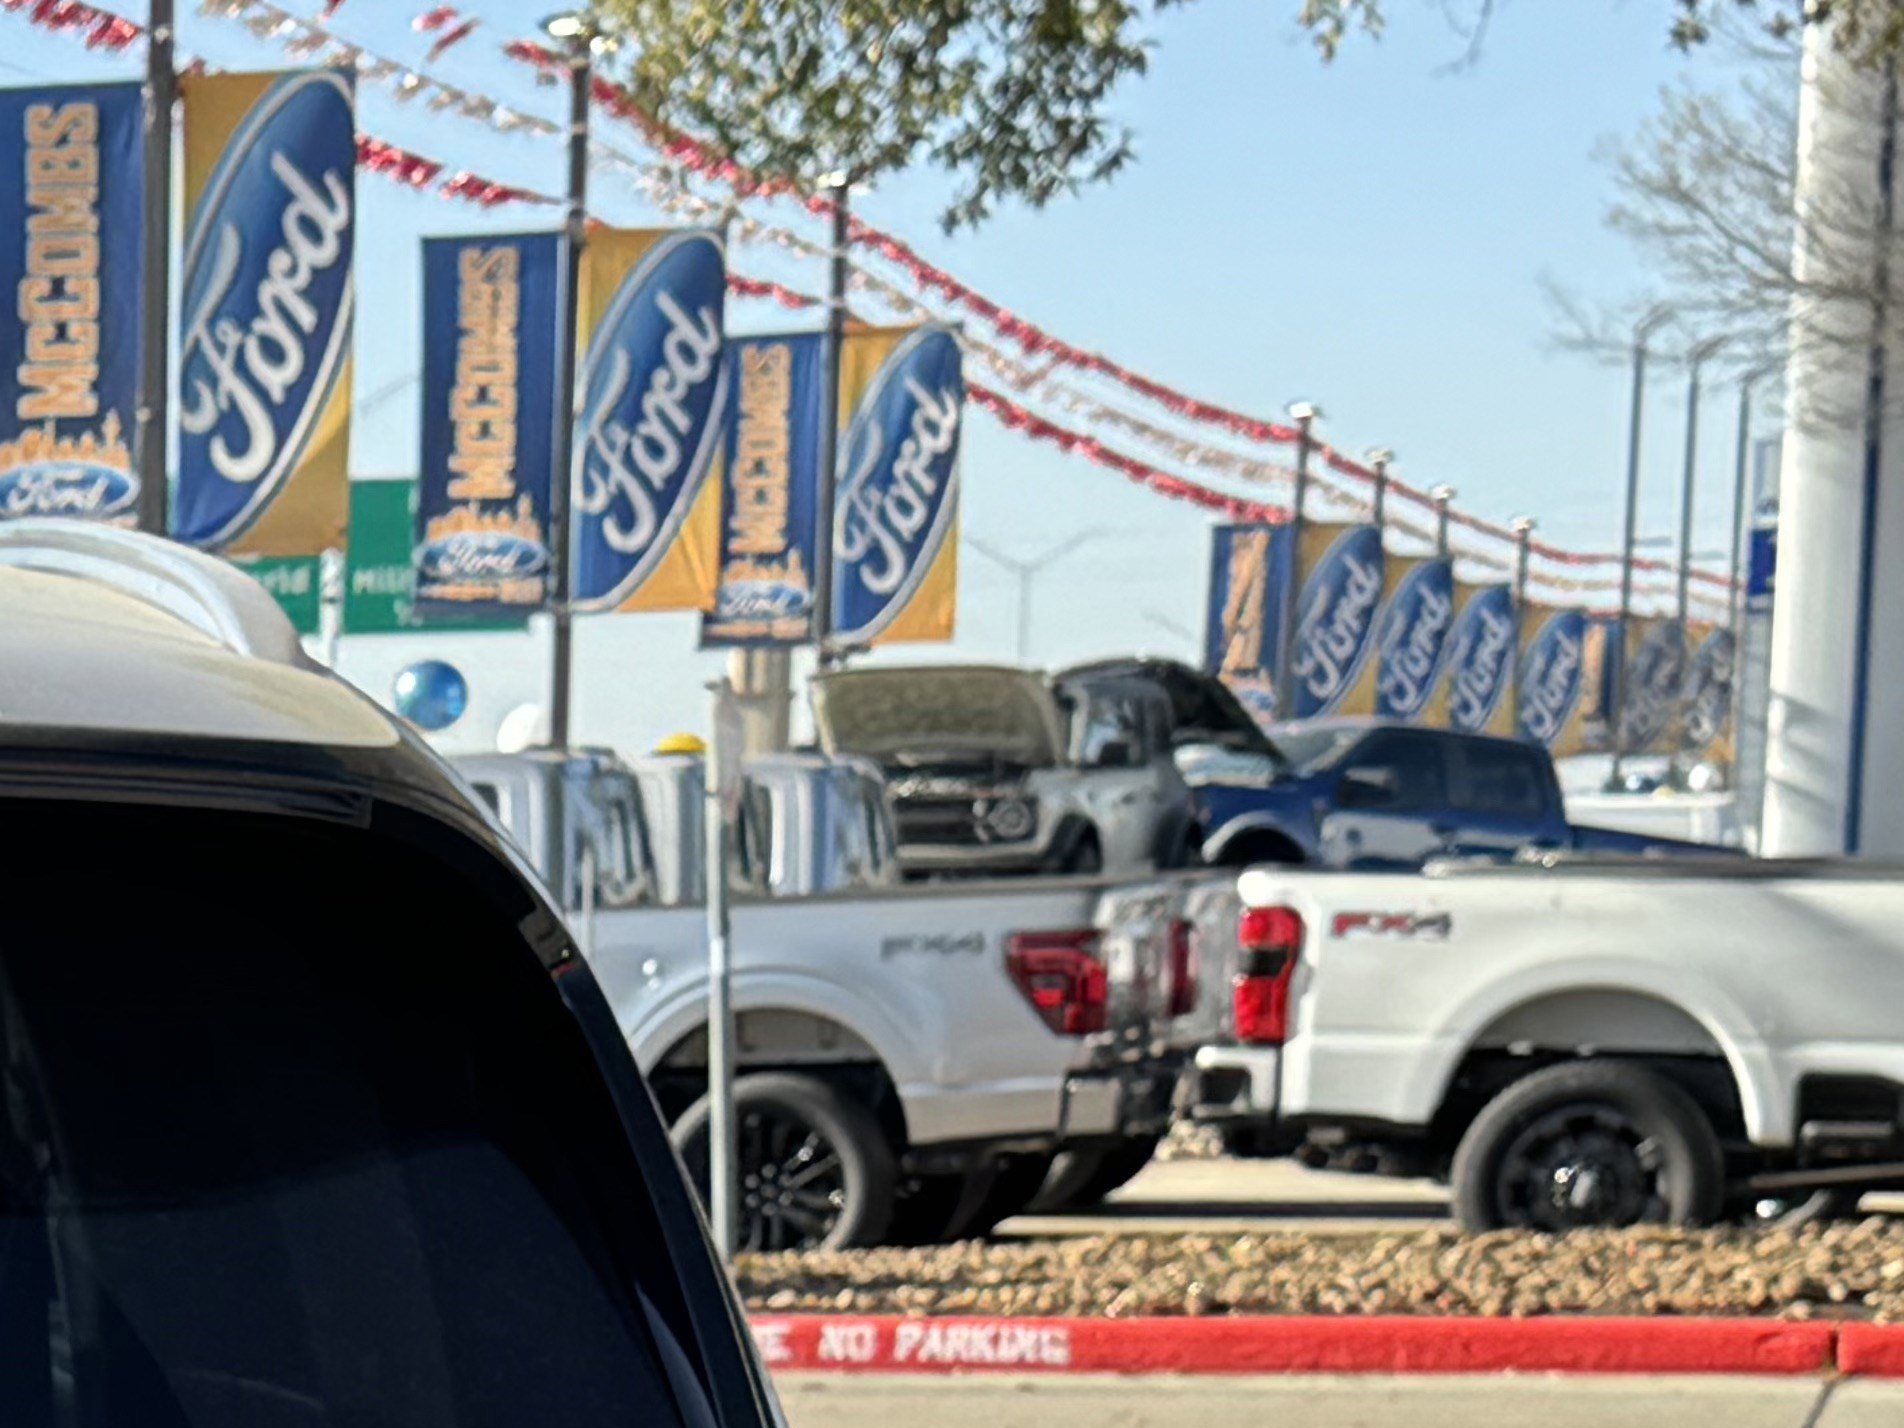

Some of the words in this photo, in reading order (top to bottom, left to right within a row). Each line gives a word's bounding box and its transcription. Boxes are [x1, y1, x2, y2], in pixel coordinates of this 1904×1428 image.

[181, 150, 348, 481] Ford
[6, 466, 110, 512] Ford
[572, 290, 720, 552] Ford
[834, 375, 956, 594] Ford
[1293, 553, 1380, 700] Ford
[1378, 581, 1452, 712] Ford
[818, 1321, 877, 1361] NO
[894, 1323, 1070, 1364] PARKING
